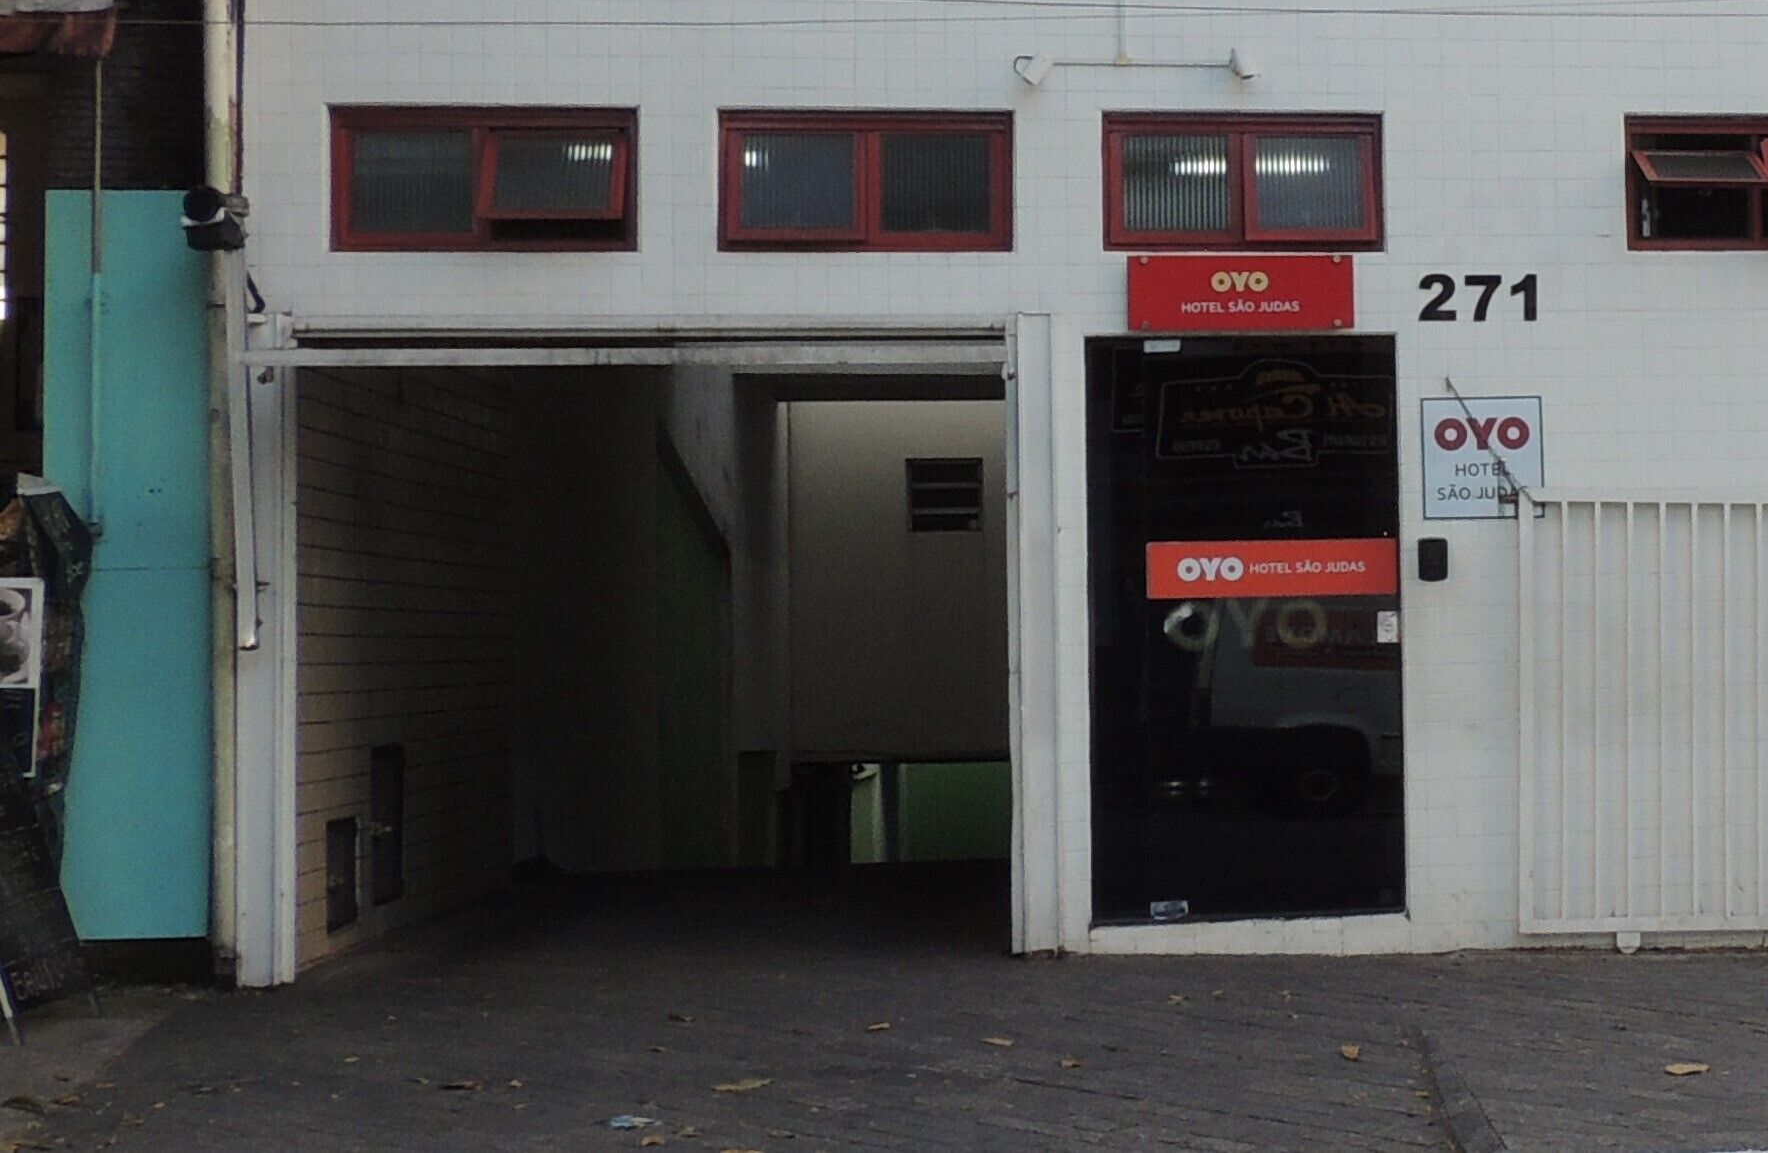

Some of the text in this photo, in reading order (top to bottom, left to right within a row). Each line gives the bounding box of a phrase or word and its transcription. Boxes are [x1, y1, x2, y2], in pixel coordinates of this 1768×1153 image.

[1210, 271, 1269, 292] OYO
[1181, 299, 1301, 314] HOTEL SÃO JUDAS
[1418, 273, 1538, 322] 271
[1433, 416, 1531, 452] OYO
[1455, 462, 1510, 476] HOTE
[1436, 484, 1472, 501] SÃO
[1177, 557, 1367, 582] OYO HOTEL SÃO JUDAS
